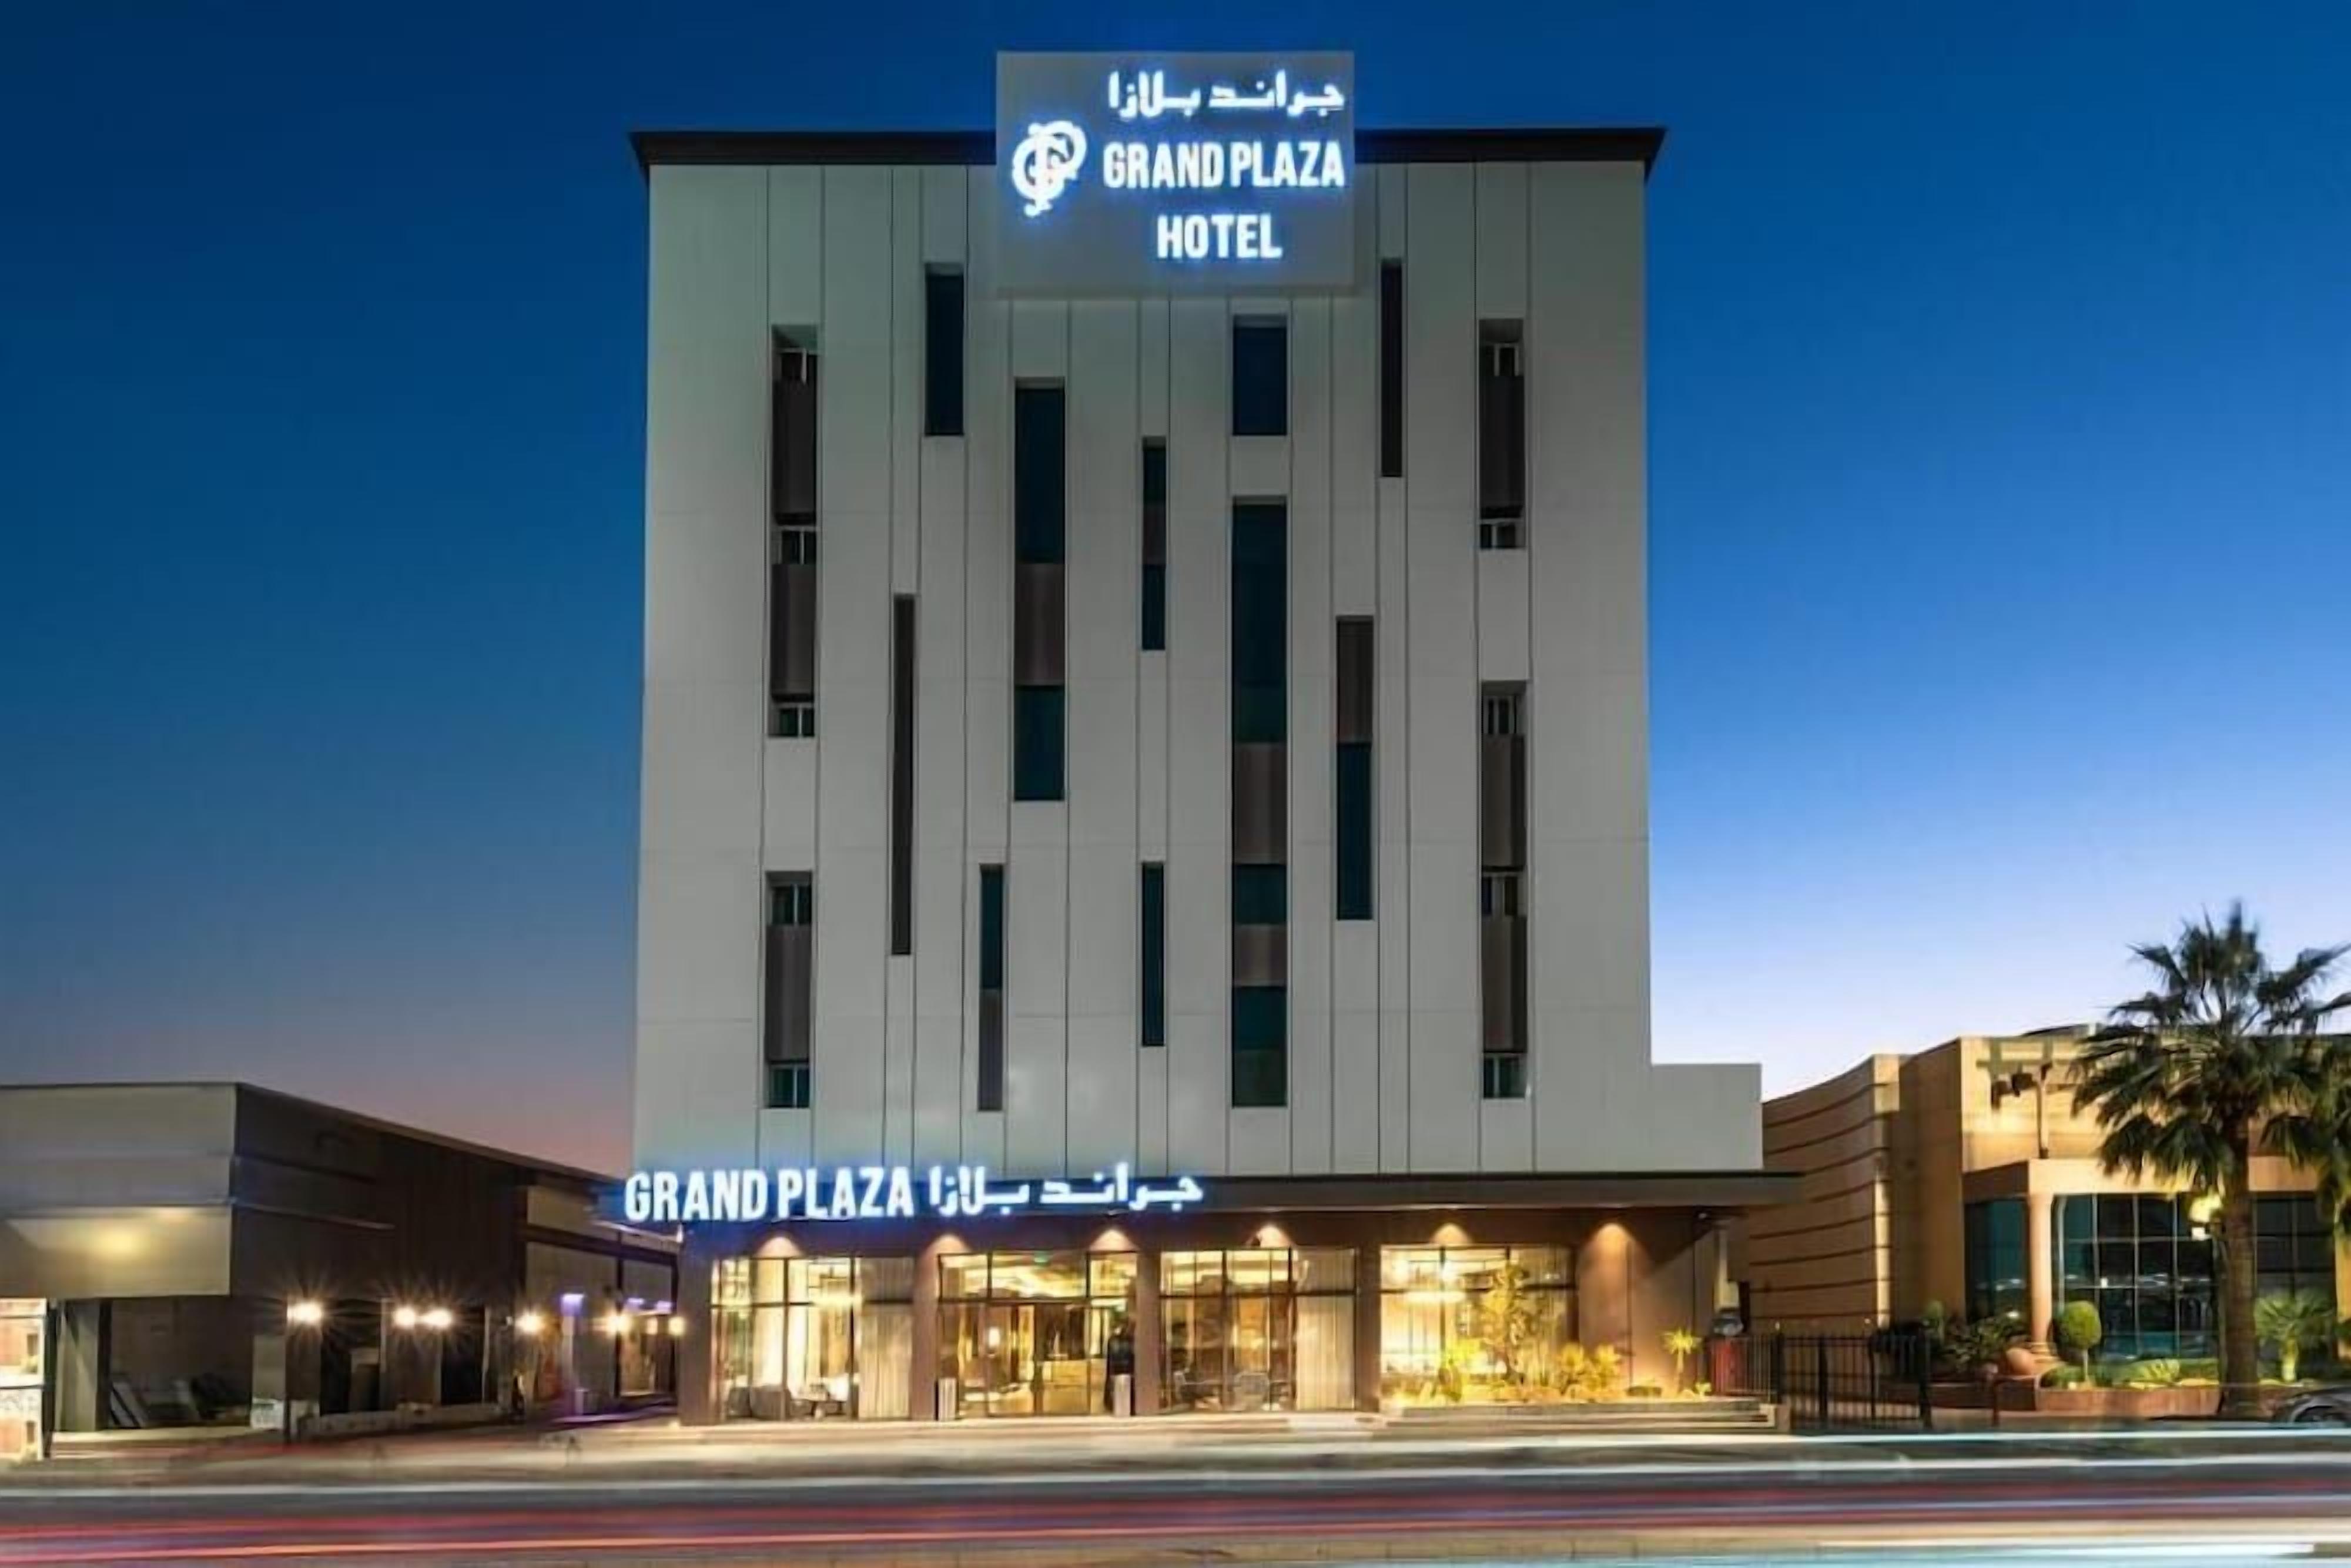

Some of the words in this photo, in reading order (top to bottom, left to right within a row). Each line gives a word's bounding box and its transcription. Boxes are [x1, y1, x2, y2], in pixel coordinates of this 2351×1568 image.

[1108, 70, 1201, 118] بلازا
[1209, 69, 1345, 116] جراند
[1103, 141, 1224, 188] GRAND
[1230, 141, 1345, 187] PLAZA
[1157, 214, 1282, 259] HOTEL
[625, 1170, 768, 1221] GRAND
[778, 1167, 915, 1218] PLAZA
[929, 1165, 1030, 1217] بلازا
[1039, 1162, 1204, 1212] جراند
